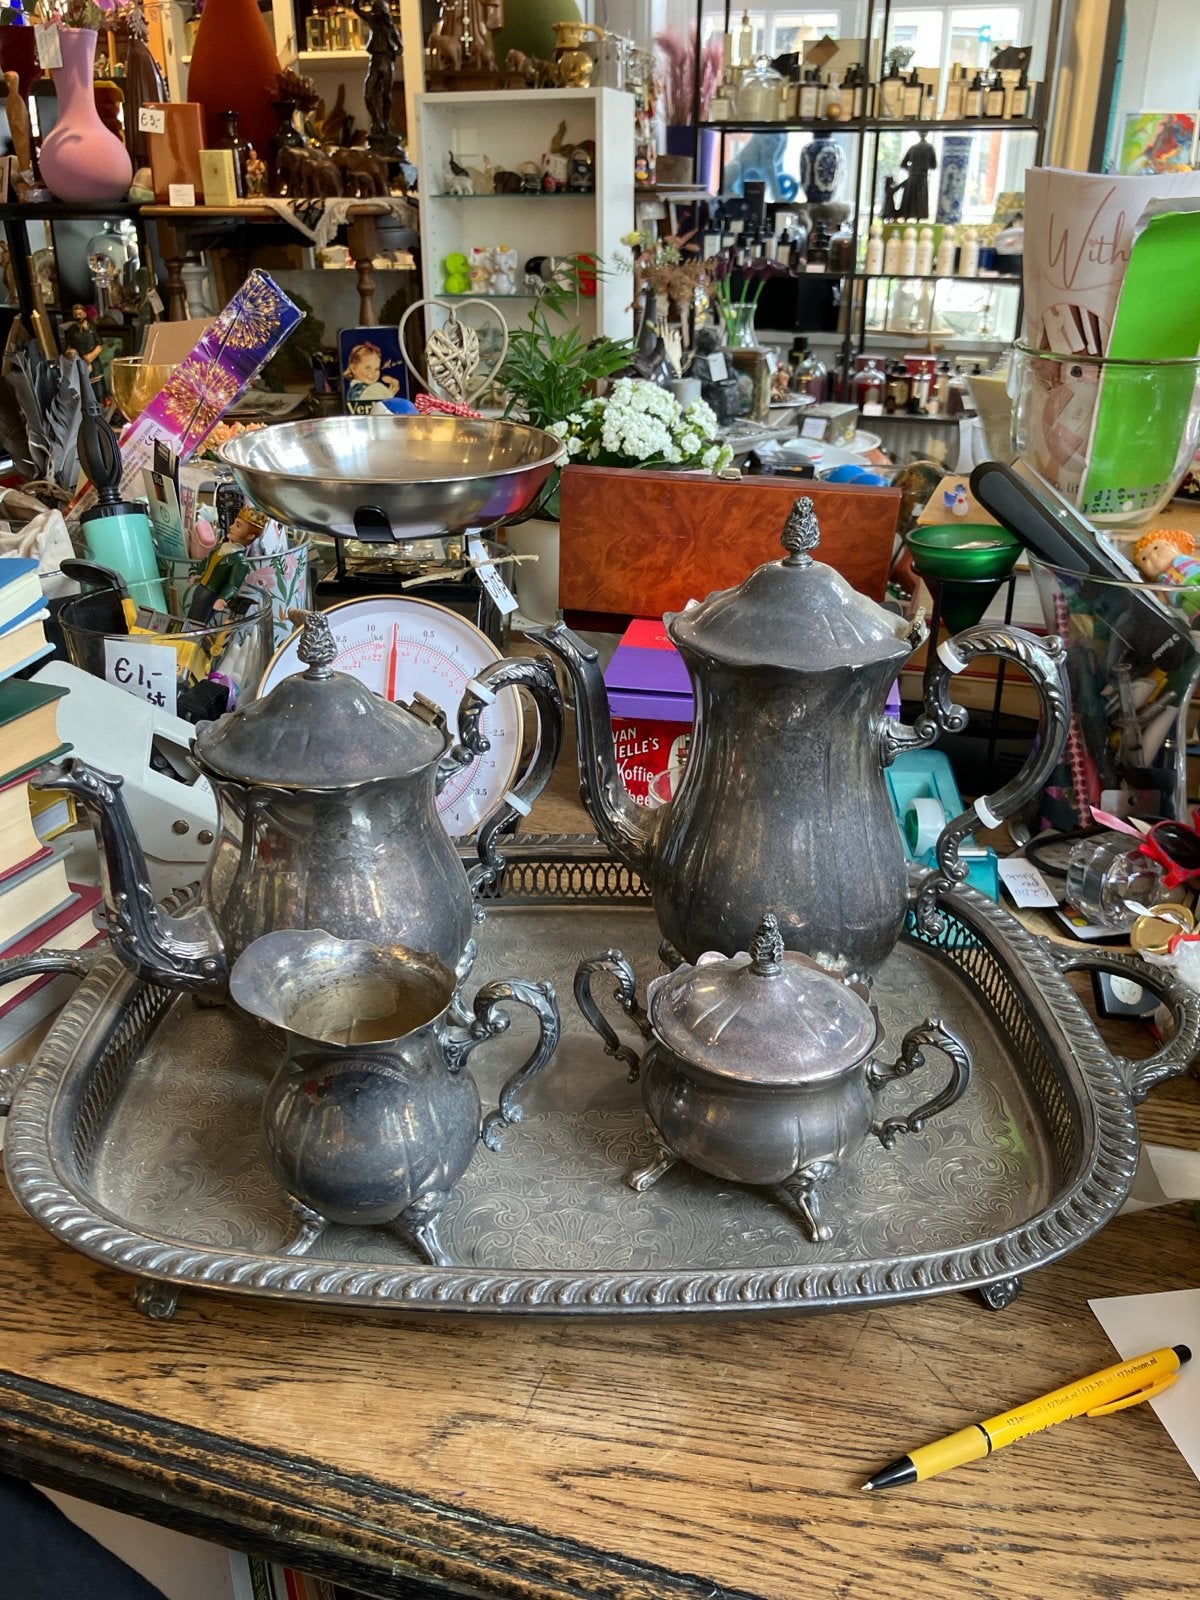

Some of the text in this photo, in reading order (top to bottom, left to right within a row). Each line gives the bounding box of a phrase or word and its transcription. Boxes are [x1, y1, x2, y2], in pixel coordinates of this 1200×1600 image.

[612, 727, 636, 743] VAN
[614, 738, 660, 760] ELLE'S
[616, 758, 654, 786] Koffie
